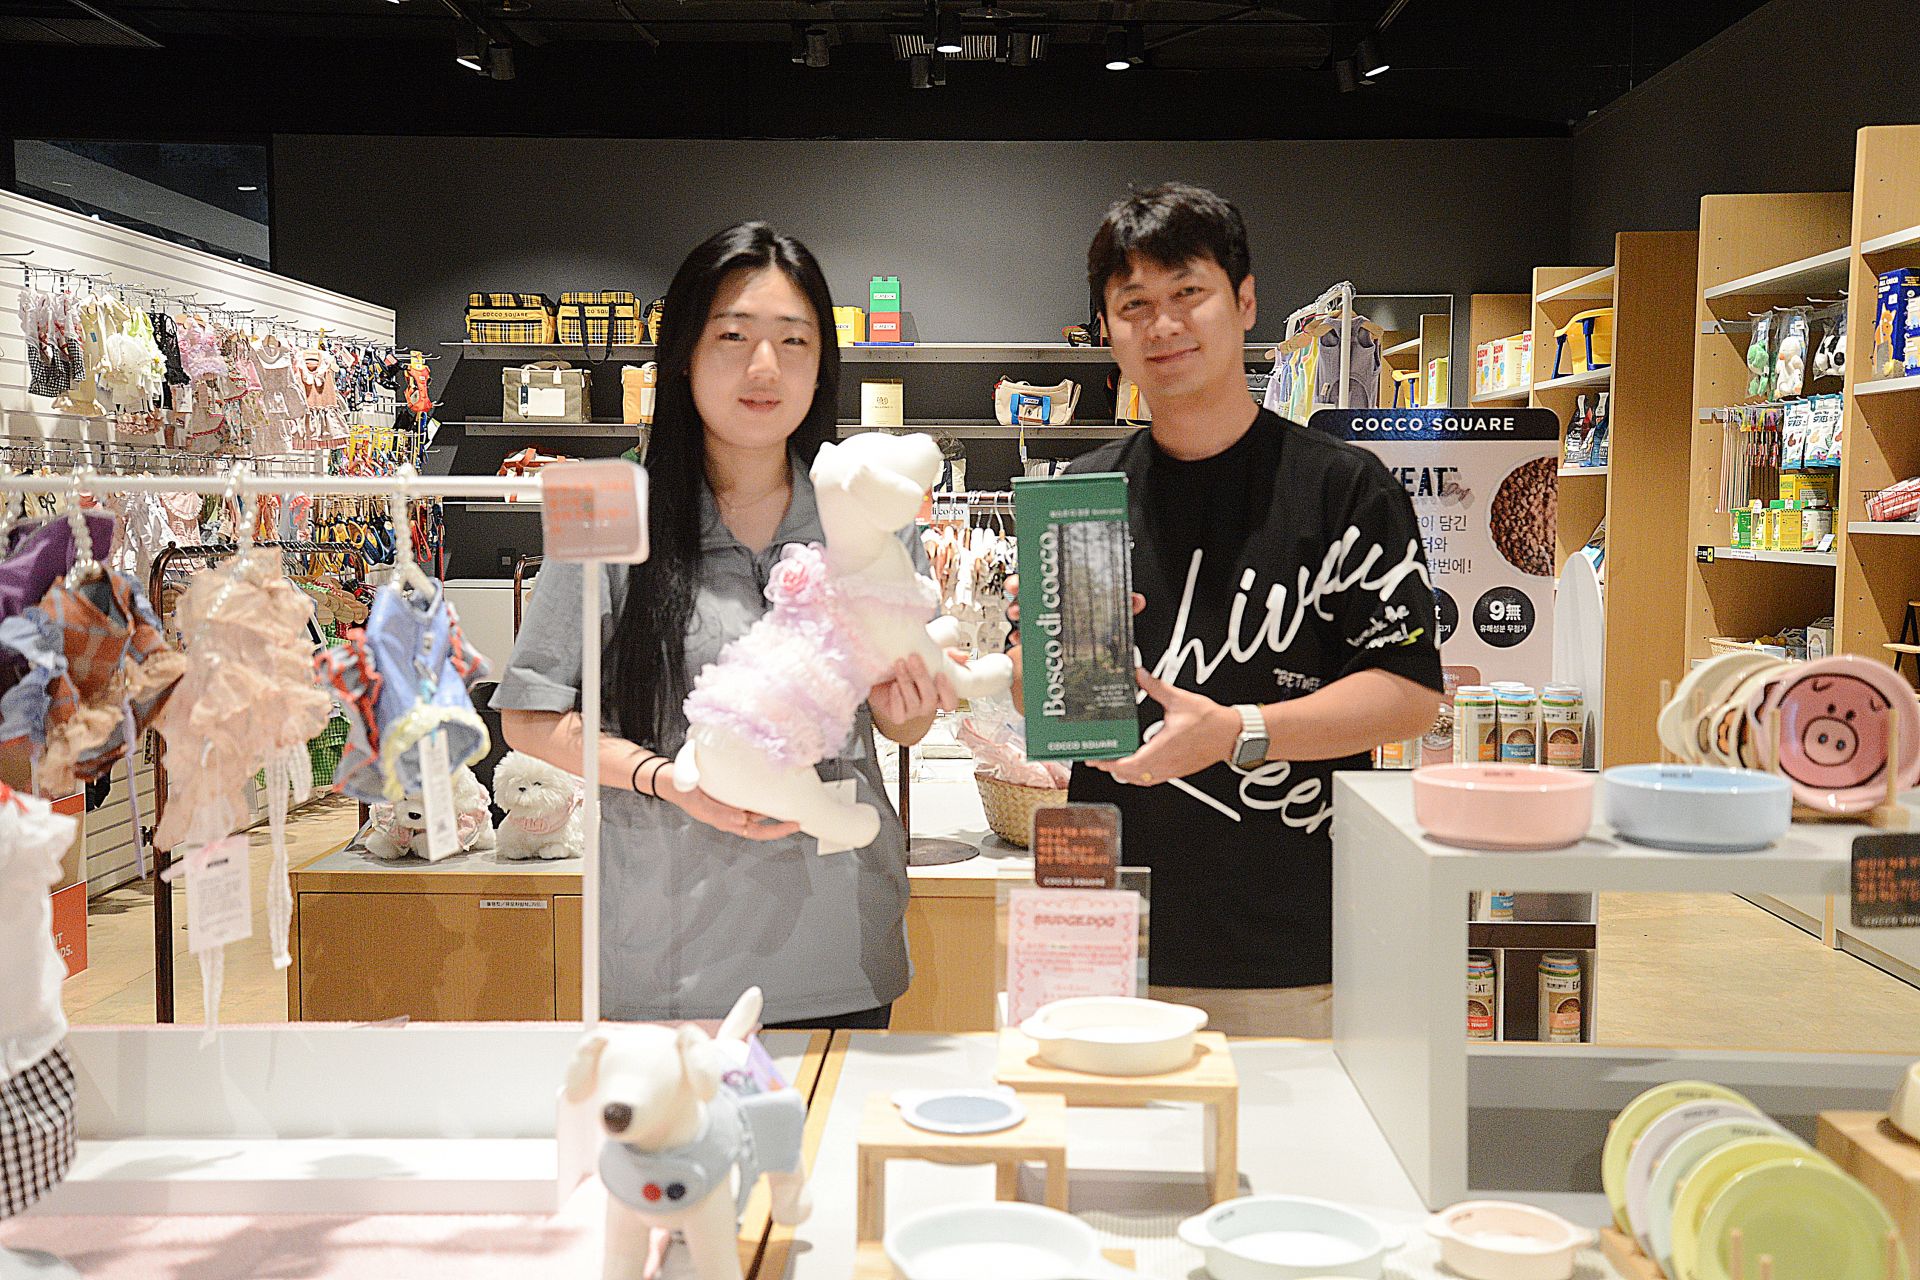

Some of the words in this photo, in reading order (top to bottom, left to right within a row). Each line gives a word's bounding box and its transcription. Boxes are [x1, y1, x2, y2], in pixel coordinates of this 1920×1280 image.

[1350, 417, 1424, 432] COCCO
[1432, 417, 1515, 432] SQUARE
[1439, 514, 1468, 532] 담긴
[1040, 531, 1061, 609] cocco
[1036, 612, 1062, 637] di
[1042, 639, 1066, 717] Bosco
